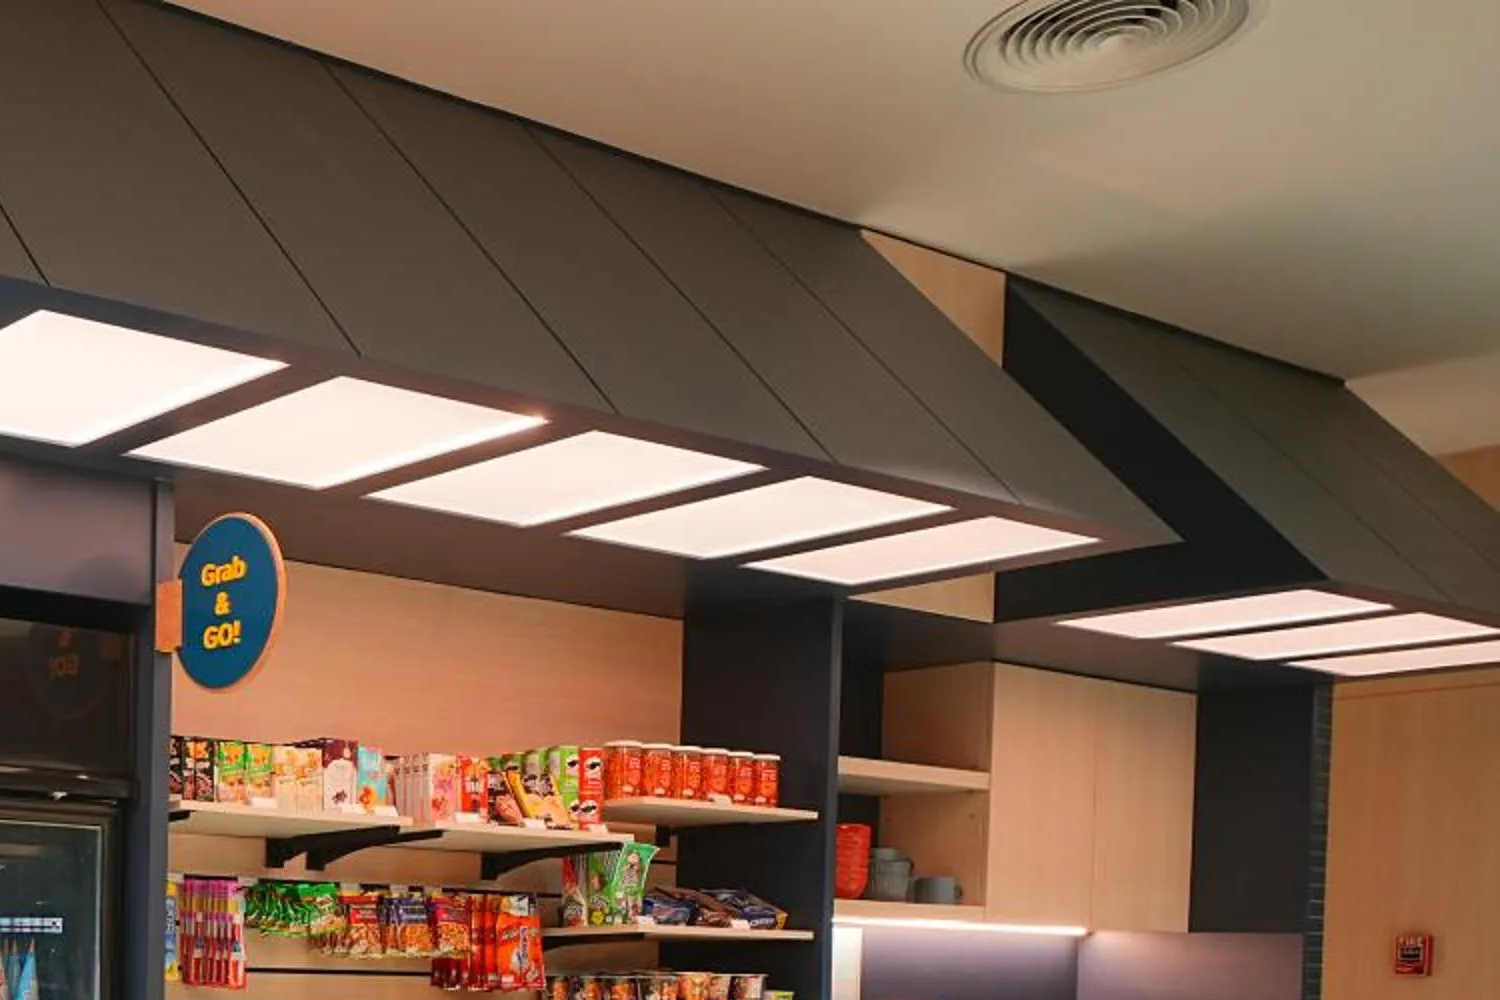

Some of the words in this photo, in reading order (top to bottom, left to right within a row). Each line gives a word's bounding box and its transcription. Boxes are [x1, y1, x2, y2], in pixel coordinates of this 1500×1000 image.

[201, 555, 247, 586] Grab
[214, 592, 231, 615] &
[203, 620, 241, 650] GO!
